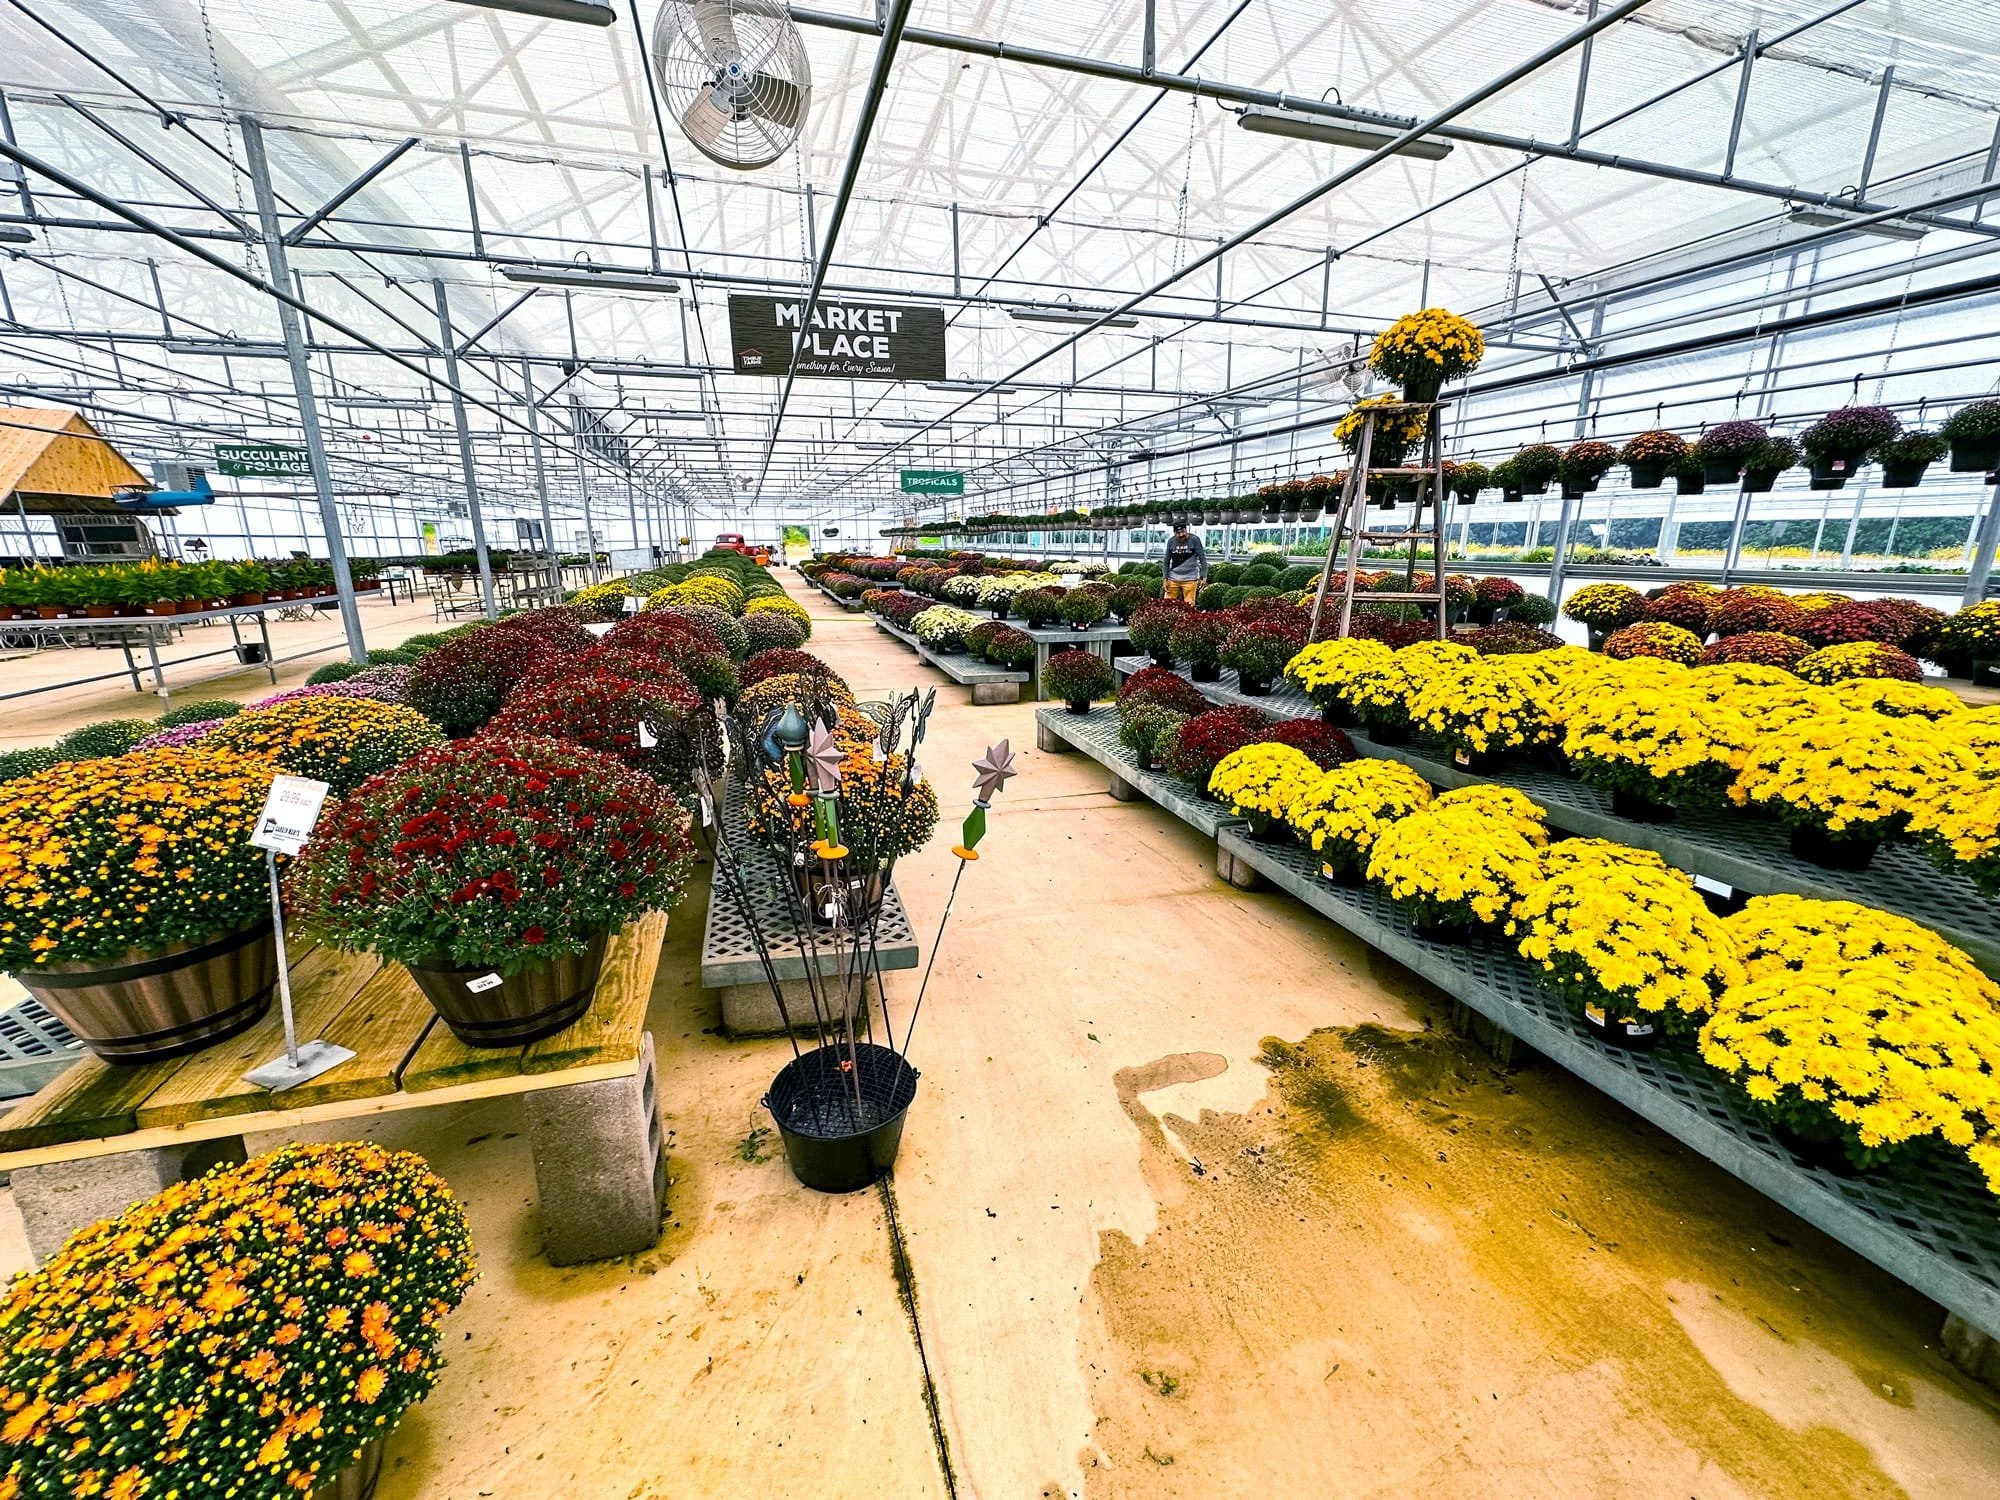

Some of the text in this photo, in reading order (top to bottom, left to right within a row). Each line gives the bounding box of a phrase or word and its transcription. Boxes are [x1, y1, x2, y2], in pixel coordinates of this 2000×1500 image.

[775, 303, 902, 333] MARKET
[791, 331, 891, 359] PLACE
[789, 360, 896, 375] omething for Every Season!
[219, 449, 308, 461] SUCCULENT
[245, 461, 311, 472] FOLIAGE
[906, 477, 958, 486] TROPICALS
